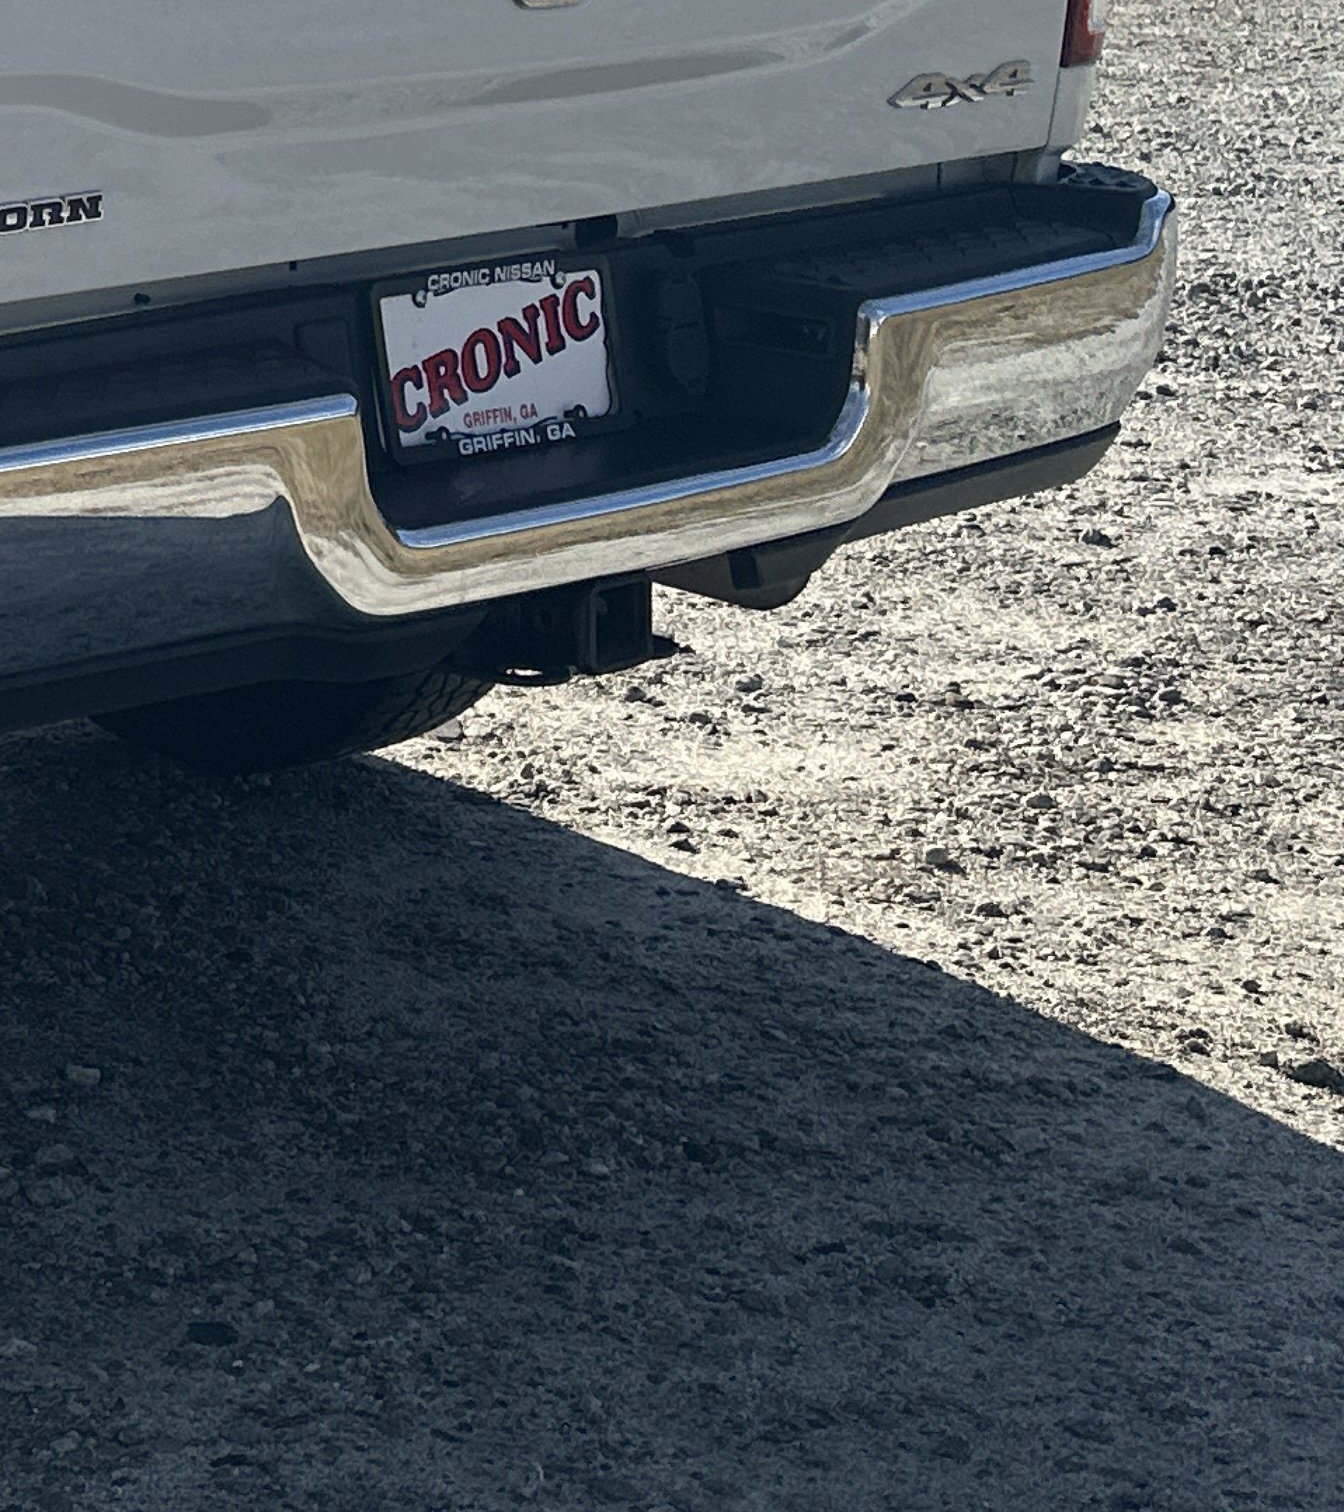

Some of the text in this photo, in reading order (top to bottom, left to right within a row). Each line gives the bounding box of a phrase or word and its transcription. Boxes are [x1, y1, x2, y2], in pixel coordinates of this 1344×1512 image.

[427, 260, 555, 290] CRONIC NISSAN
[389, 276, 601, 433] CRONIC
[463, 403, 538, 429] GRIFFIN, GA
[458, 422, 576, 455] GRIFFIN, GA
